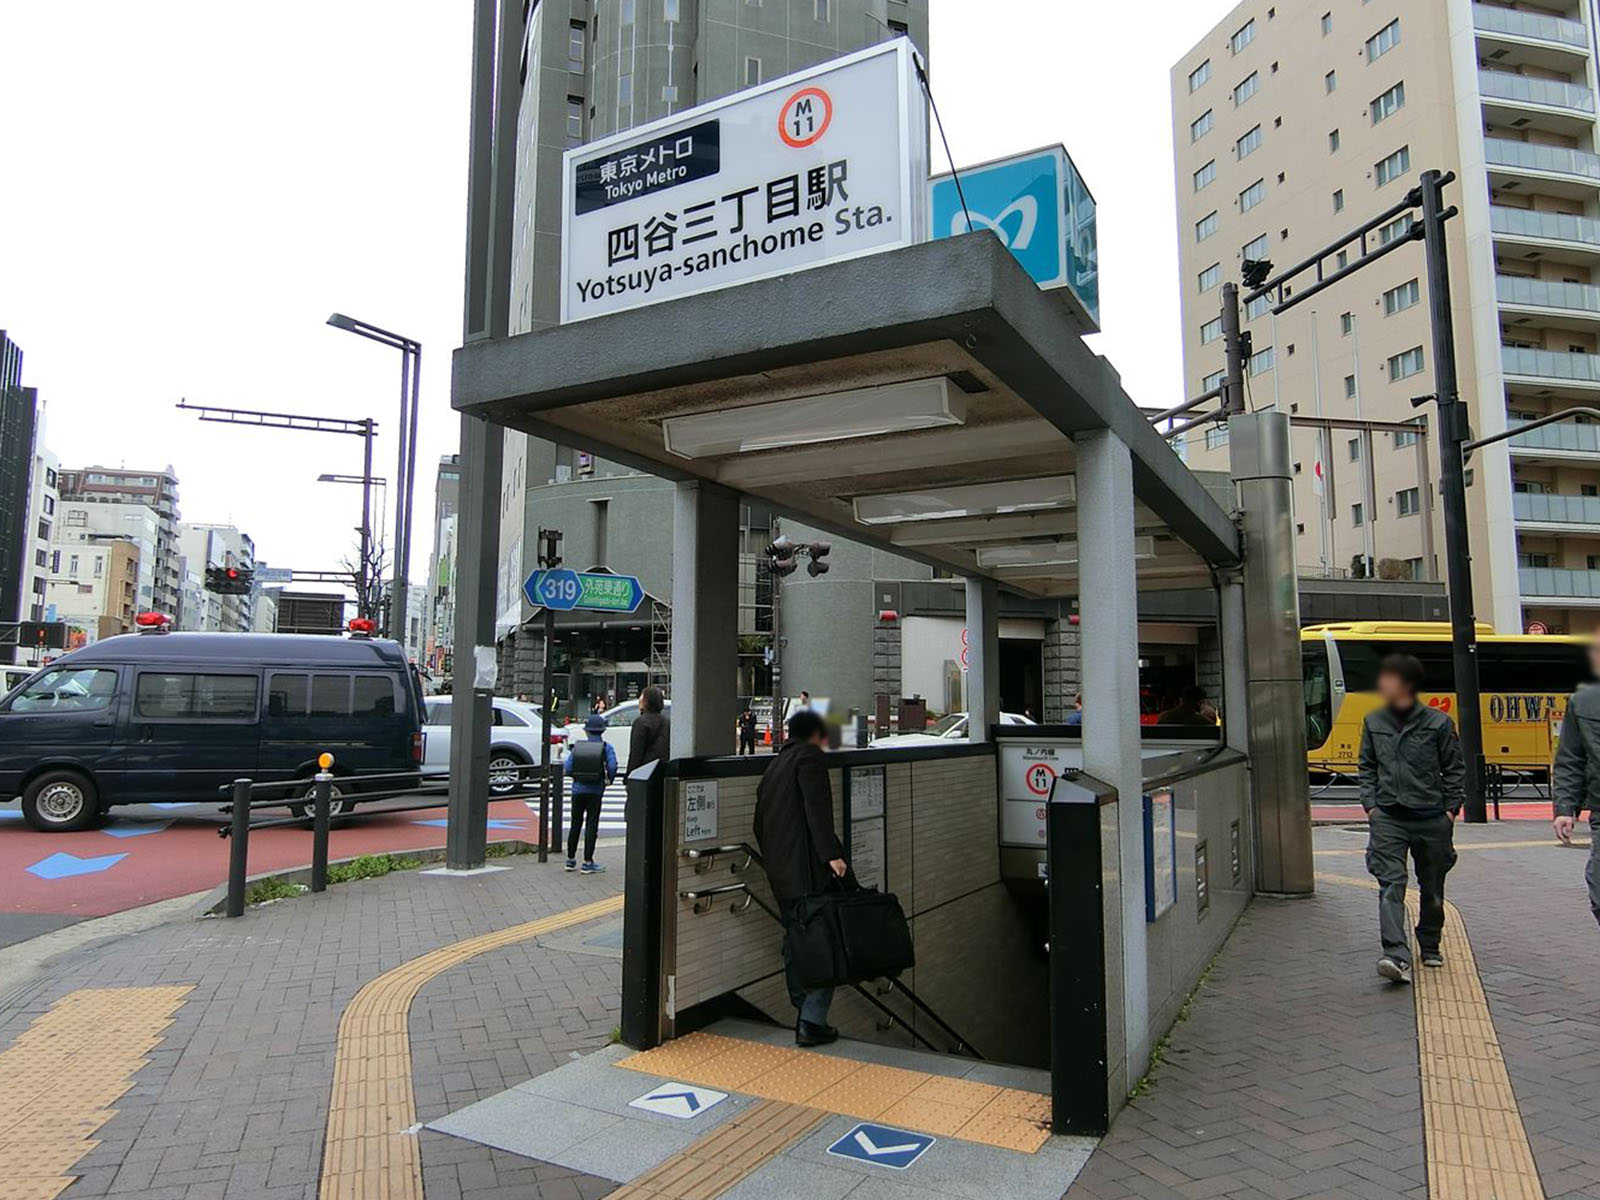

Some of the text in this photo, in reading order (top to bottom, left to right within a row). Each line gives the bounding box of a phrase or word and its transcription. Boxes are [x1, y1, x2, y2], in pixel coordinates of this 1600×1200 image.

[795, 99, 812, 117] M
[793, 117, 814, 137] 11
[599, 136, 693, 185] 東京メトロ
[604, 165, 687, 200] Tokyo Metro
[607, 159, 849, 268] 四谷三丁目駅
[577, 203, 893, 304] Yotsuya-sanchome Sta.
[544, 578, 577, 600] 319
[1035, 778, 1046, 788] 11
[1036, 769, 1045, 777] M
